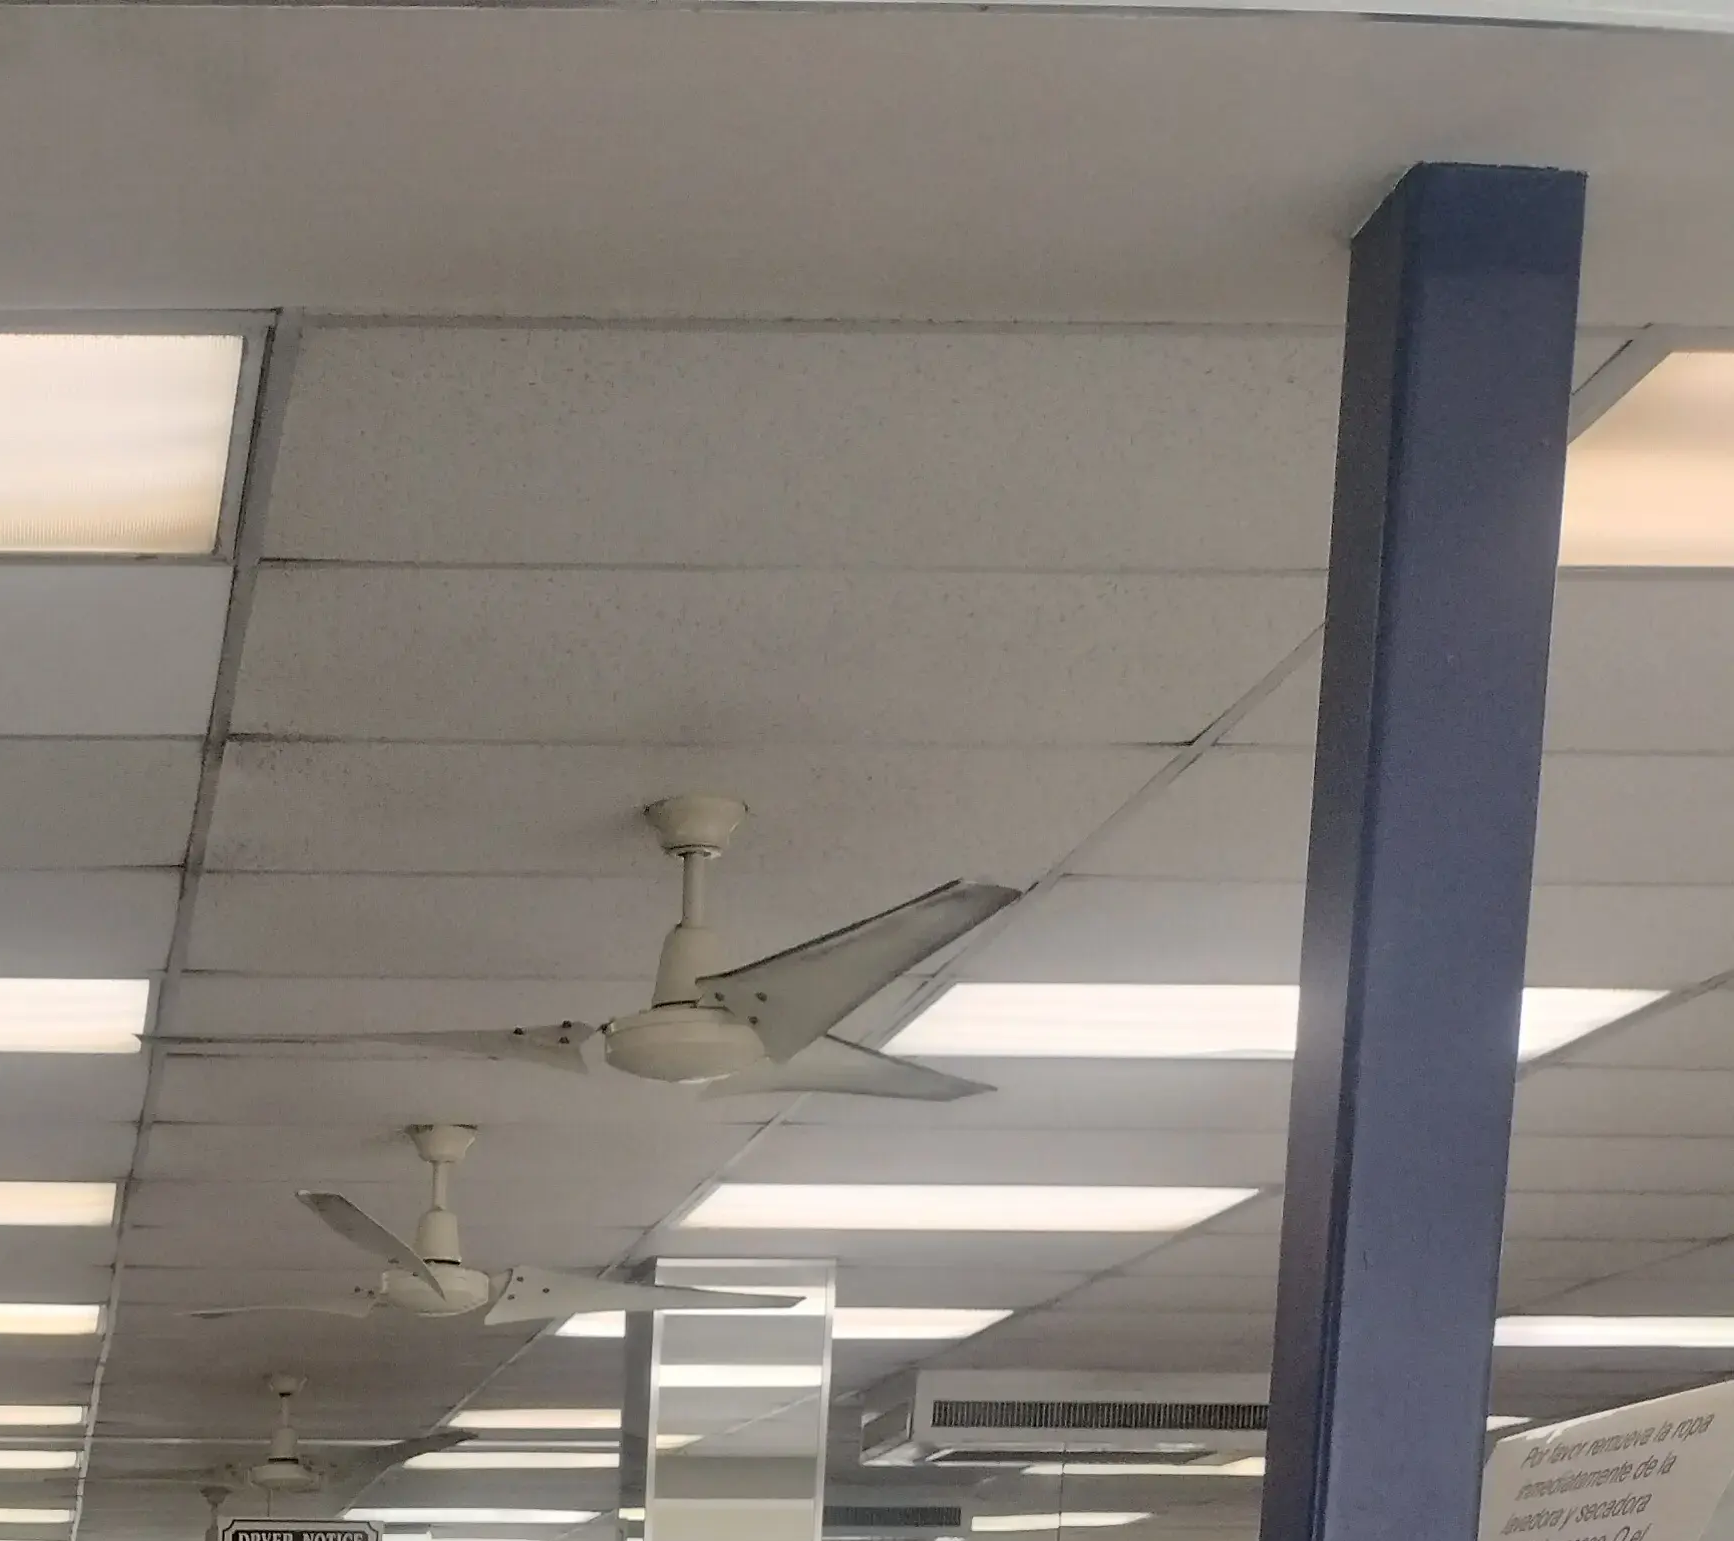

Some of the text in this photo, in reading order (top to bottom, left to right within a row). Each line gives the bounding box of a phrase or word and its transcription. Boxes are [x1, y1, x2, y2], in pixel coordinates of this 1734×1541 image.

[1521, 1413, 1715, 1469] Por favor remueva la ropa
[1632, 1454, 1657, 1479] de
[1656, 1449, 1678, 1476] la
[1557, 1506, 1579, 1531] y
[1574, 1492, 1653, 1523] secadora
